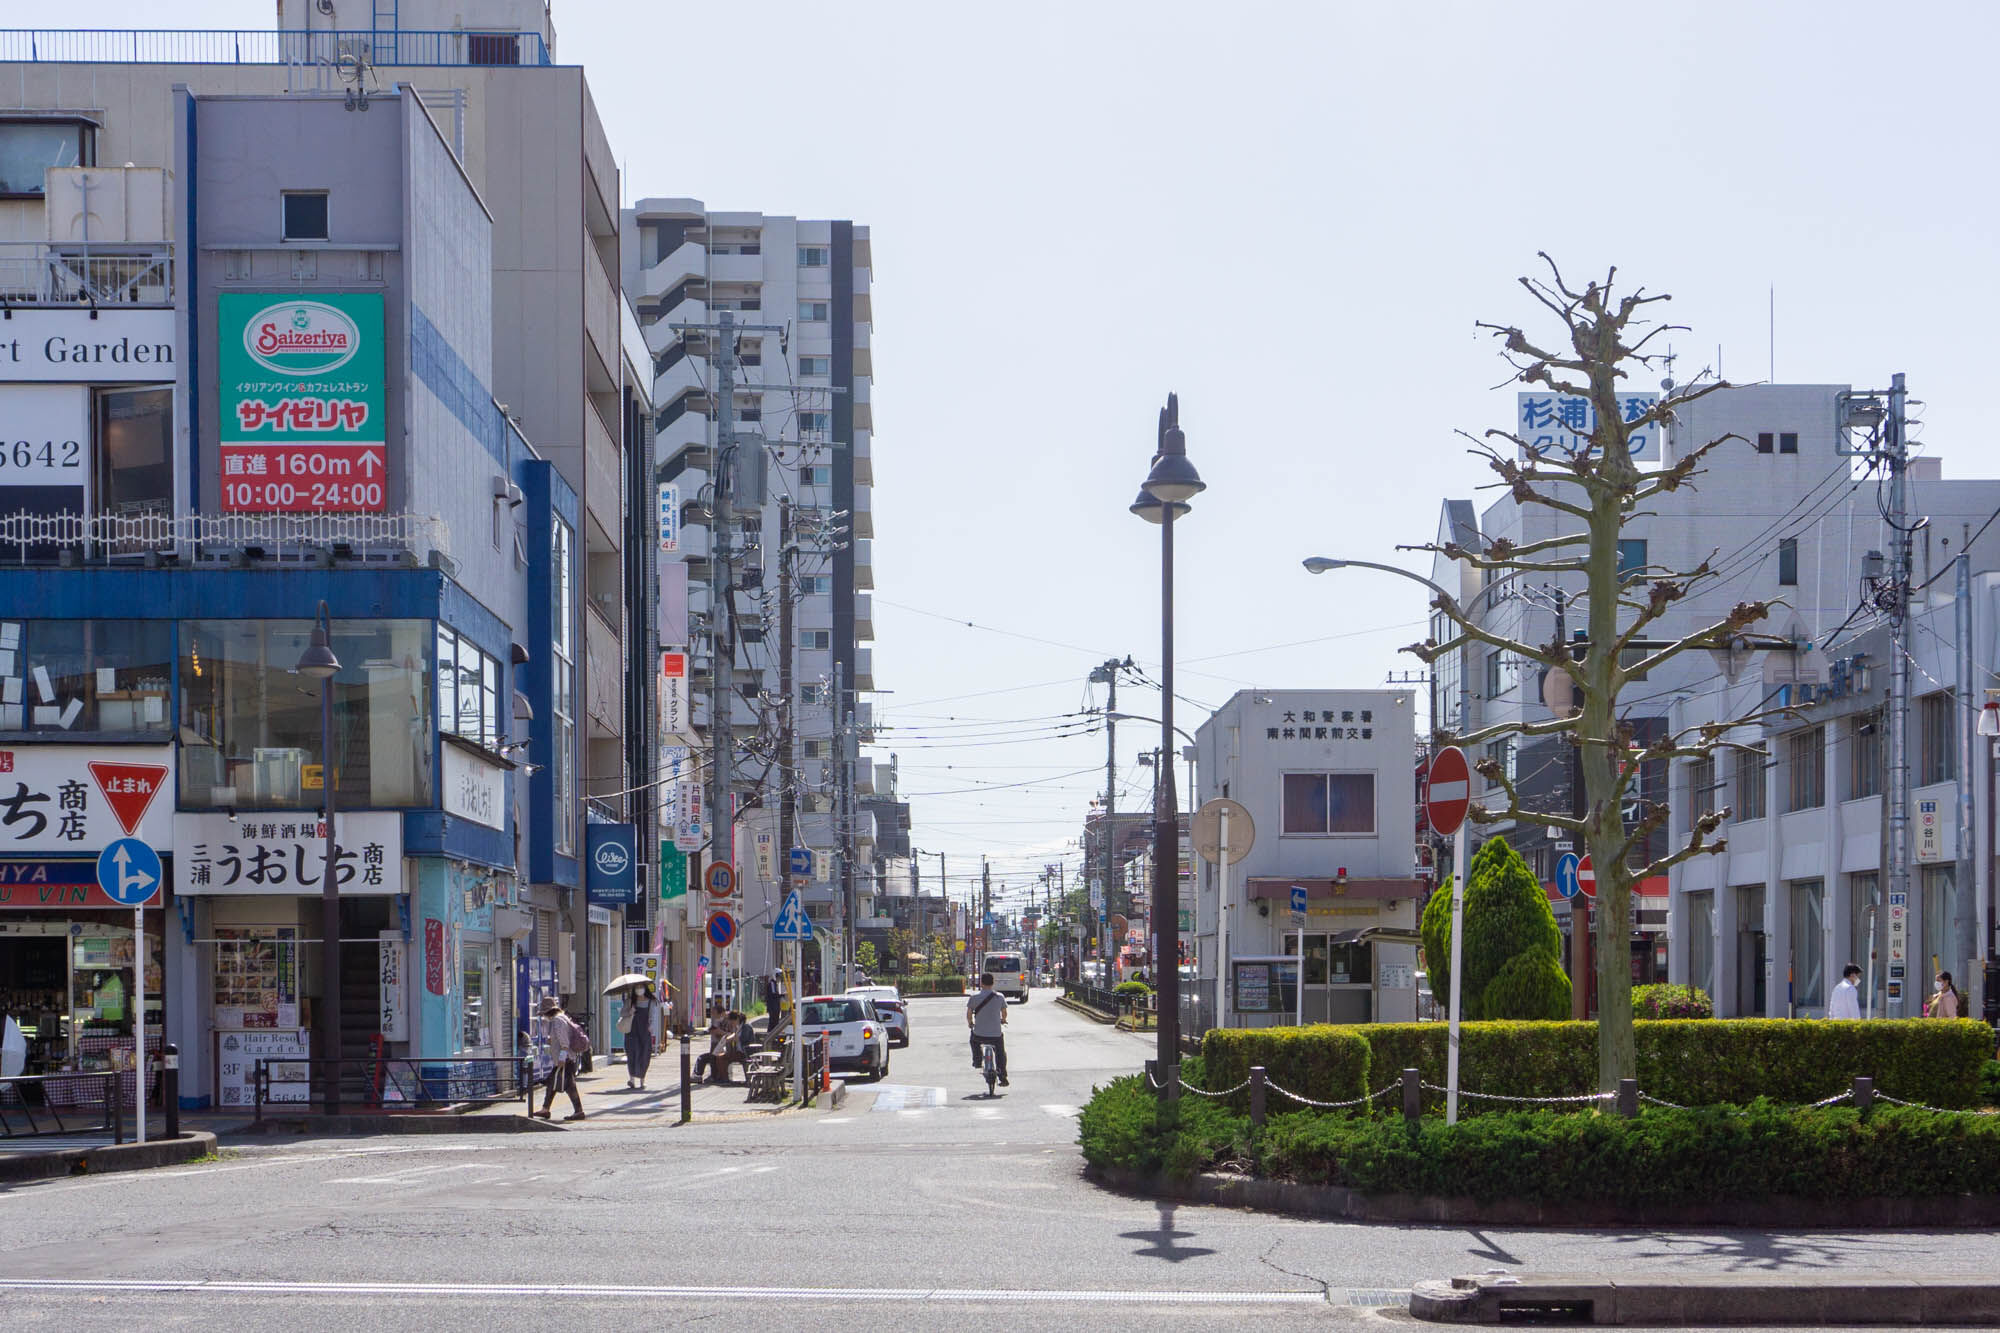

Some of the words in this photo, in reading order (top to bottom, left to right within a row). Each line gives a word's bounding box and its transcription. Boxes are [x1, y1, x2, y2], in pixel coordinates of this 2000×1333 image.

[257, 323, 347, 352] Saizeriya
[44, 337, 175, 363] Garden
[238, 399, 367, 431] サイゼリヤ
[1523, 397, 1655, 429] 杉浦科
[224, 454, 267, 476] 直進
[275, 454, 350, 475] 160m
[670, 700, 678, 732] グラント
[1283, 710, 1373, 723] 大和警察署
[1267, 727, 1373, 740] 南林間駅前交番
[106, 776, 153, 794] 止まれ
[56, 779, 89, 842] 商店
[242, 823, 316, 839] 海鮮酒場
[190, 846, 212, 885] 三浦
[362, 843, 385, 885] 商店
[712, 871, 729, 888] 40
[39, 887, 88, 902] VIN
[382, 950, 393, 1023] うおしち
[244, 1033, 268, 1043] Hair
[223, 1063, 241, 1076] 3F
